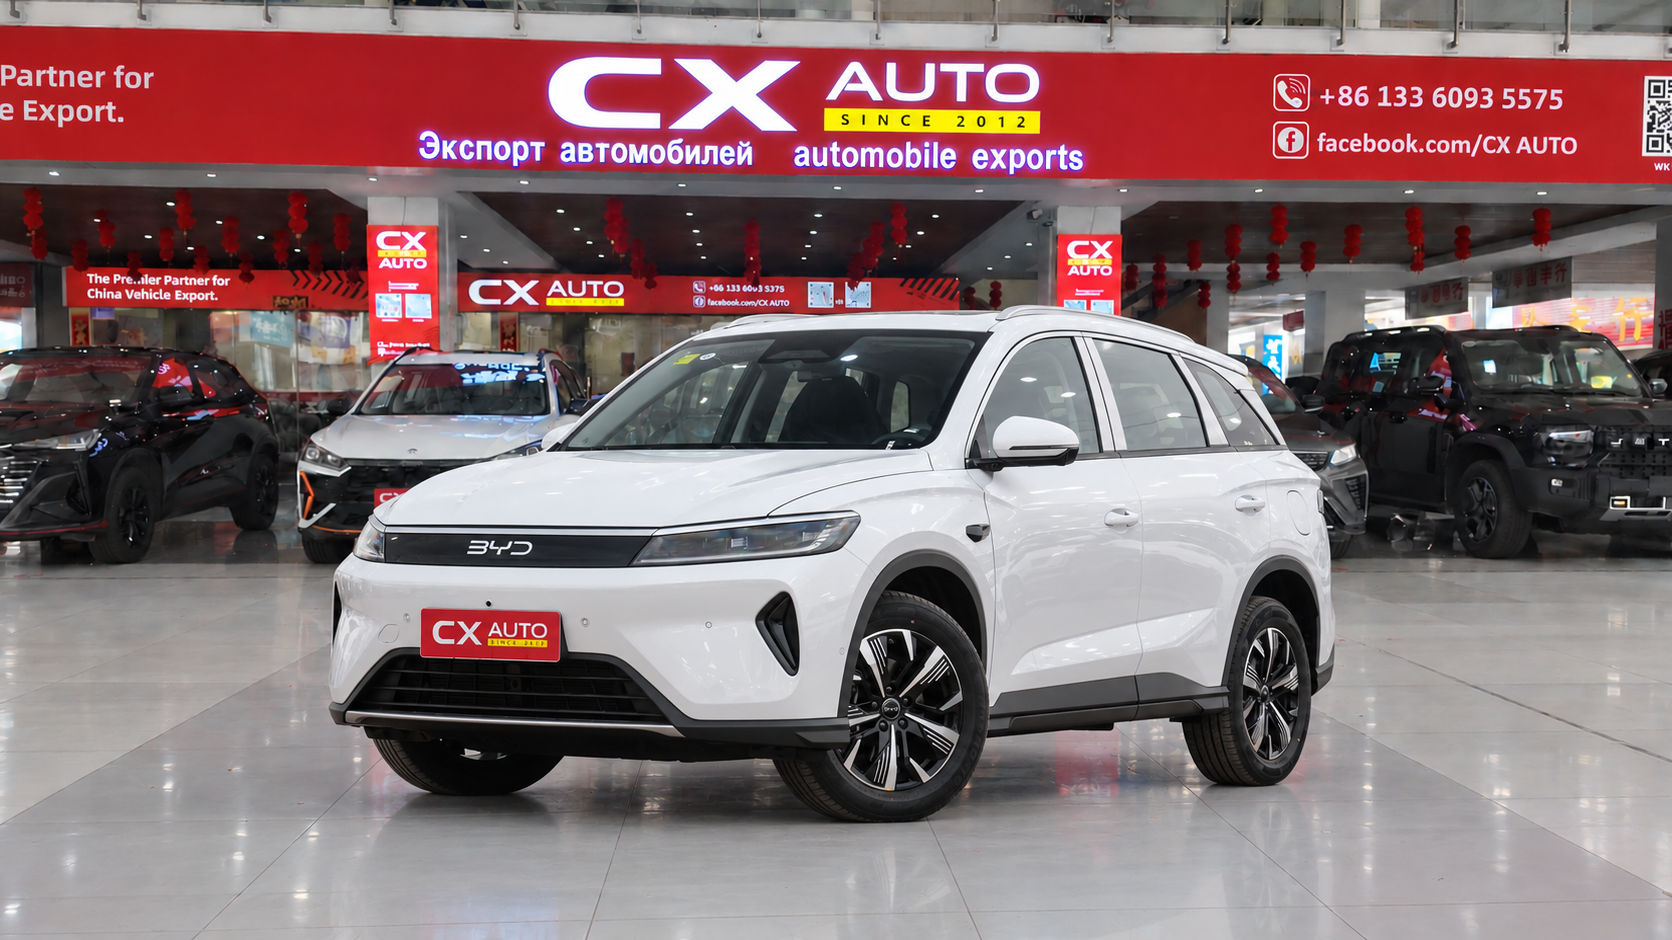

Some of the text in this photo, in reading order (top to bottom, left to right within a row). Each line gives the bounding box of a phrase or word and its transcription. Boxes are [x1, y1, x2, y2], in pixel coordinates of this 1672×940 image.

[0, 64, 155, 89] Partner for
[548, 56, 1040, 132] CX AUTO
[1320, 85, 1563, 110] +86 133 6093 5575
[23, 99, 124, 127] Export.
[841, 113, 1026, 129] SINCE 2012
[418, 131, 753, 166] Экспорт автомобилей
[1316, 132, 1578, 157] facebook.com/CX AUTO
[793, 141, 1084, 175] automobile exports
[375, 230, 427, 251] CX
[1066, 240, 1113, 260] CX
[378, 257, 428, 269] AUTO
[1067, 265, 1113, 276] AUTO
[87, 273, 110, 284] The
[164, 275, 210, 286] Partner
[211, 275, 231, 286] for
[87, 288, 219, 303] China Vehicle Export.
[468, 279, 625, 306] CX AUTO
[769, 299, 790, 307] AUTO
[467, 540, 533, 556] BYD
[432, 620, 548, 646] CX AUTO
